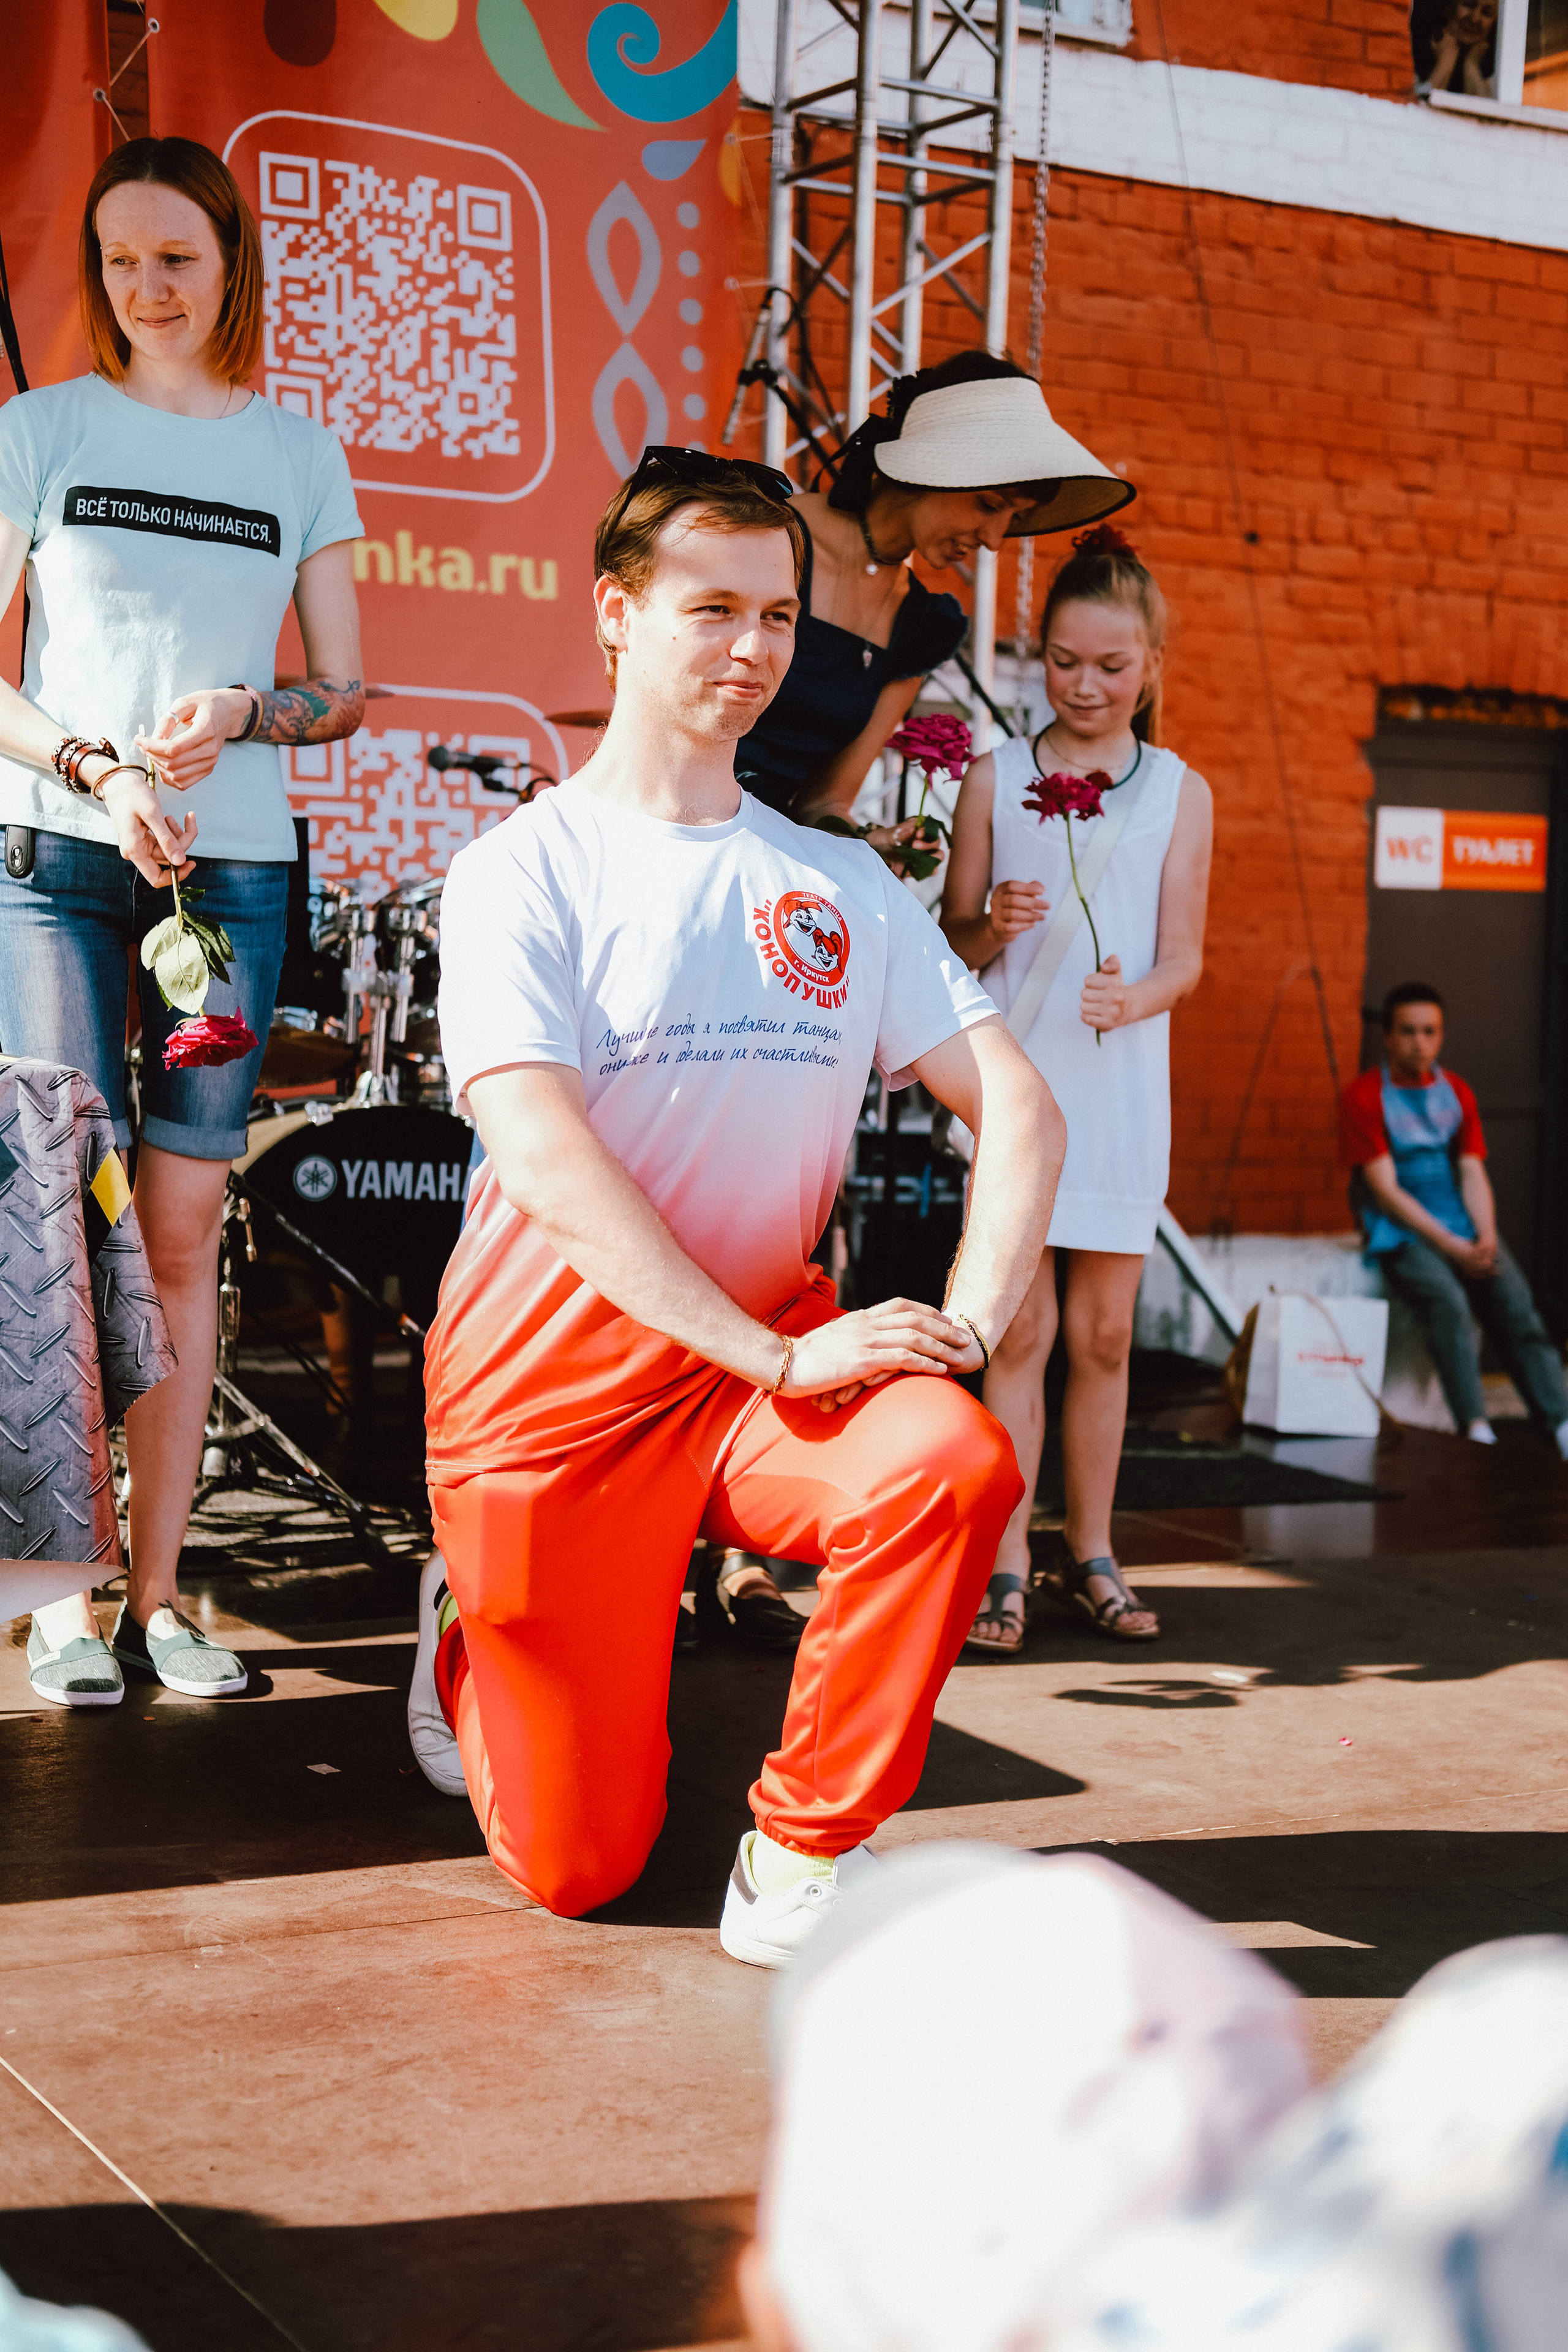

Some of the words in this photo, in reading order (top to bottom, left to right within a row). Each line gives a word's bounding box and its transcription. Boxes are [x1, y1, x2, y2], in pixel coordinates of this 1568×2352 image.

[75, 497, 107, 517] ВСЁ
[110, 500, 171, 526] ТОЛЬКО
[1386, 834, 1434, 865] WC
[801, 892, 823, 902] ТЕАТР
[824, 900, 843, 922] ТАНЦА
[801, 964, 830, 983] Иркутск
[666, 1013, 696, 1036] годы
[703, 1022, 710, 1034] я
[718, 1014, 786, 1034] посвятил
[657, 1051, 669, 1063] и
[676, 1040, 725, 1063] сделали
[730, 1047, 748, 1060] их
